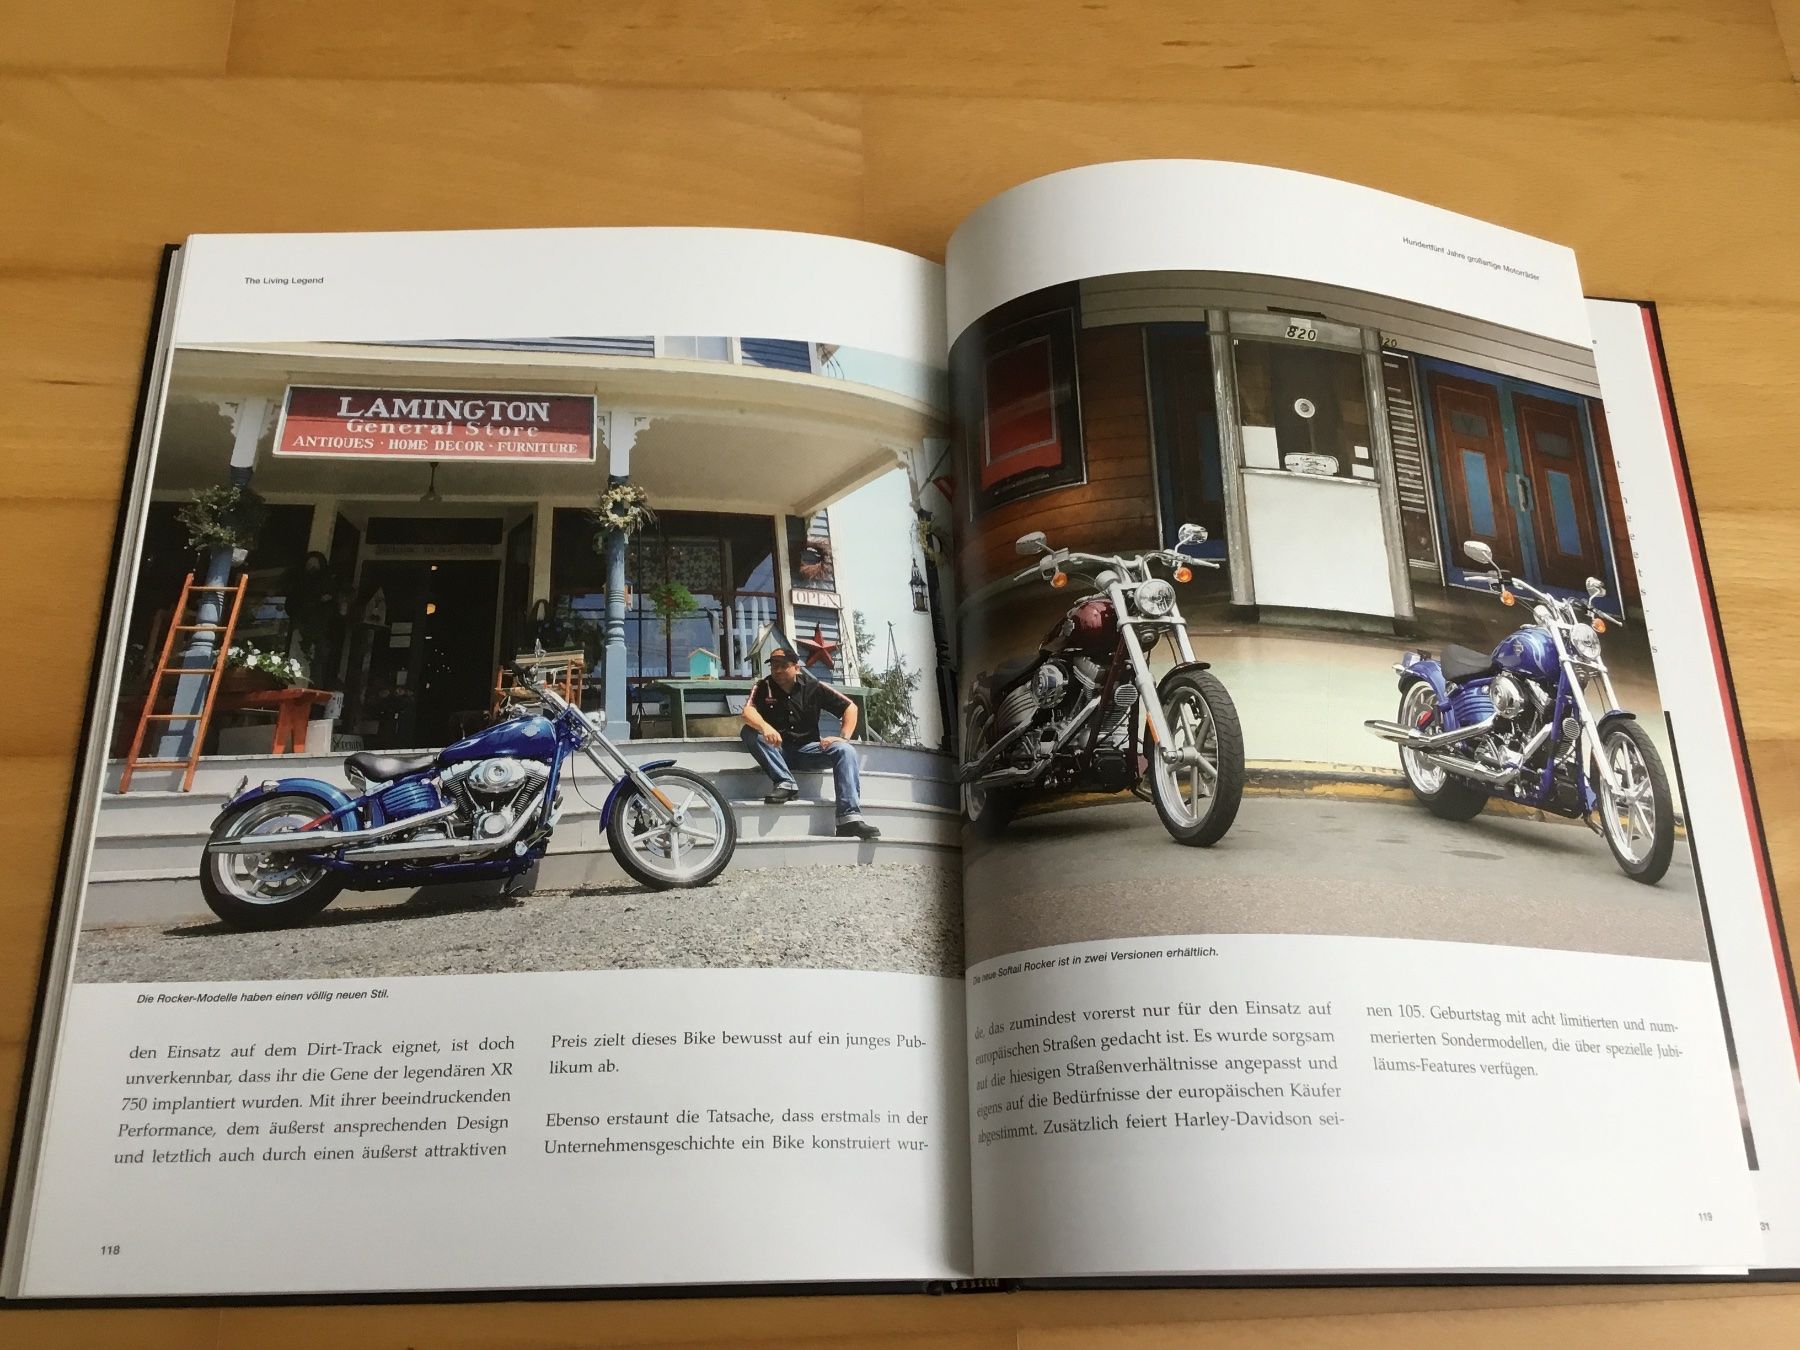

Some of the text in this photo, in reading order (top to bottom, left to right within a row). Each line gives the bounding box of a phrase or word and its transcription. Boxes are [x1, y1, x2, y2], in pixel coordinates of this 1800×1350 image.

[292, 277, 324, 285] Legend
[1287, 326, 1316, 341] 820
[337, 397, 550, 422] LAMINGTON
[346, 418, 540, 437] General Store
[293, 435, 578, 454] ANTIQUES HOME DECOR FURNITURE
[998, 964, 1021, 977] Softail
[1024, 960, 1056, 971] Rocker
[1058, 957, 1069, 966] ist
[1073, 956, 1081, 964] in
[1084, 952, 1107, 963] zwei
[1111, 950, 1162, 960] Versionen
[1166, 947, 1218, 957] erhältlich.
[137, 994, 154, 1003] Die
[157, 993, 237, 1003] Rocker-Modelle
[240, 993, 272, 1001] haben
[276, 992, 303, 1001] einen
[307, 991, 333, 1001] völlig
[371, 989, 388, 998] Stil.
[989, 1022, 1004, 1035] das
[1010, 1011, 1077, 1031] zumindest
[1083, 1006, 1135, 1020] vorerst
[1143, 1006, 1170, 1017] nur
[1178, 1002, 1201, 1015] für
[1209, 1001, 1238, 1014] den
[1245, 1001, 1301, 1014] Einsatz
[1309, 1001, 1331, 1015] auf
[1367, 1004, 1678, 1032] nen 105. Geburtstag mit acht limitierten und num-
[130, 1036, 514, 1059] den Einsatz auf dem Dirt-Track eignet, ist doch
[551, 1031, 926, 1050] Preis zielt dieses Bike bewusst auf ein junges Pub-
[975, 1028, 1335, 1066] europäischen Straßen gedacht ist. Es wurde sorgsam
[1370, 1031, 1683, 1059] merierten Sondermodellen, die über spezielle Jubi-
[126, 1063, 512, 1085] unverkennbar, dass ihr die Gene der legendären XR
[550, 1059, 618, 1074] likum ab.
[991, 1073, 1005, 1086] die
[1010, 1067, 1061, 1084] hiesigen
[1067, 1057, 1217, 1076] Straßenverhältnisse
[1225, 1057, 1301, 1074] angepasst
[1308, 1056, 1338, 1069] und
[1373, 1056, 1538, 1079] läums-Features verfügen.
[122, 1089, 510, 1114] 750 implantiert wurden. Mit ihrer beeindruckenden
[977, 1082, 1341, 1120] eigens auf die Bedürfnisse der europäischen Käufer
[118, 1116, 508, 1137] Performance, dem äußerst ansprechenden Design
[546, 1108, 928, 1126] Ebenso erstaunt die Tatsache, dass erstmals in der
[978, 1111, 1344, 1146] abgestimmt. Zusätzlich feiert Harley-Davidson sei-
[115, 1143, 506, 1163] und letztlich auch durch einen äußerst attraktiven
[545, 1135, 928, 1155] Unternehmensgeschichte ein Bike konstruiert wur-
[1698, 1212, 1712, 1222] 119
[101, 1245, 120, 1255] 118
